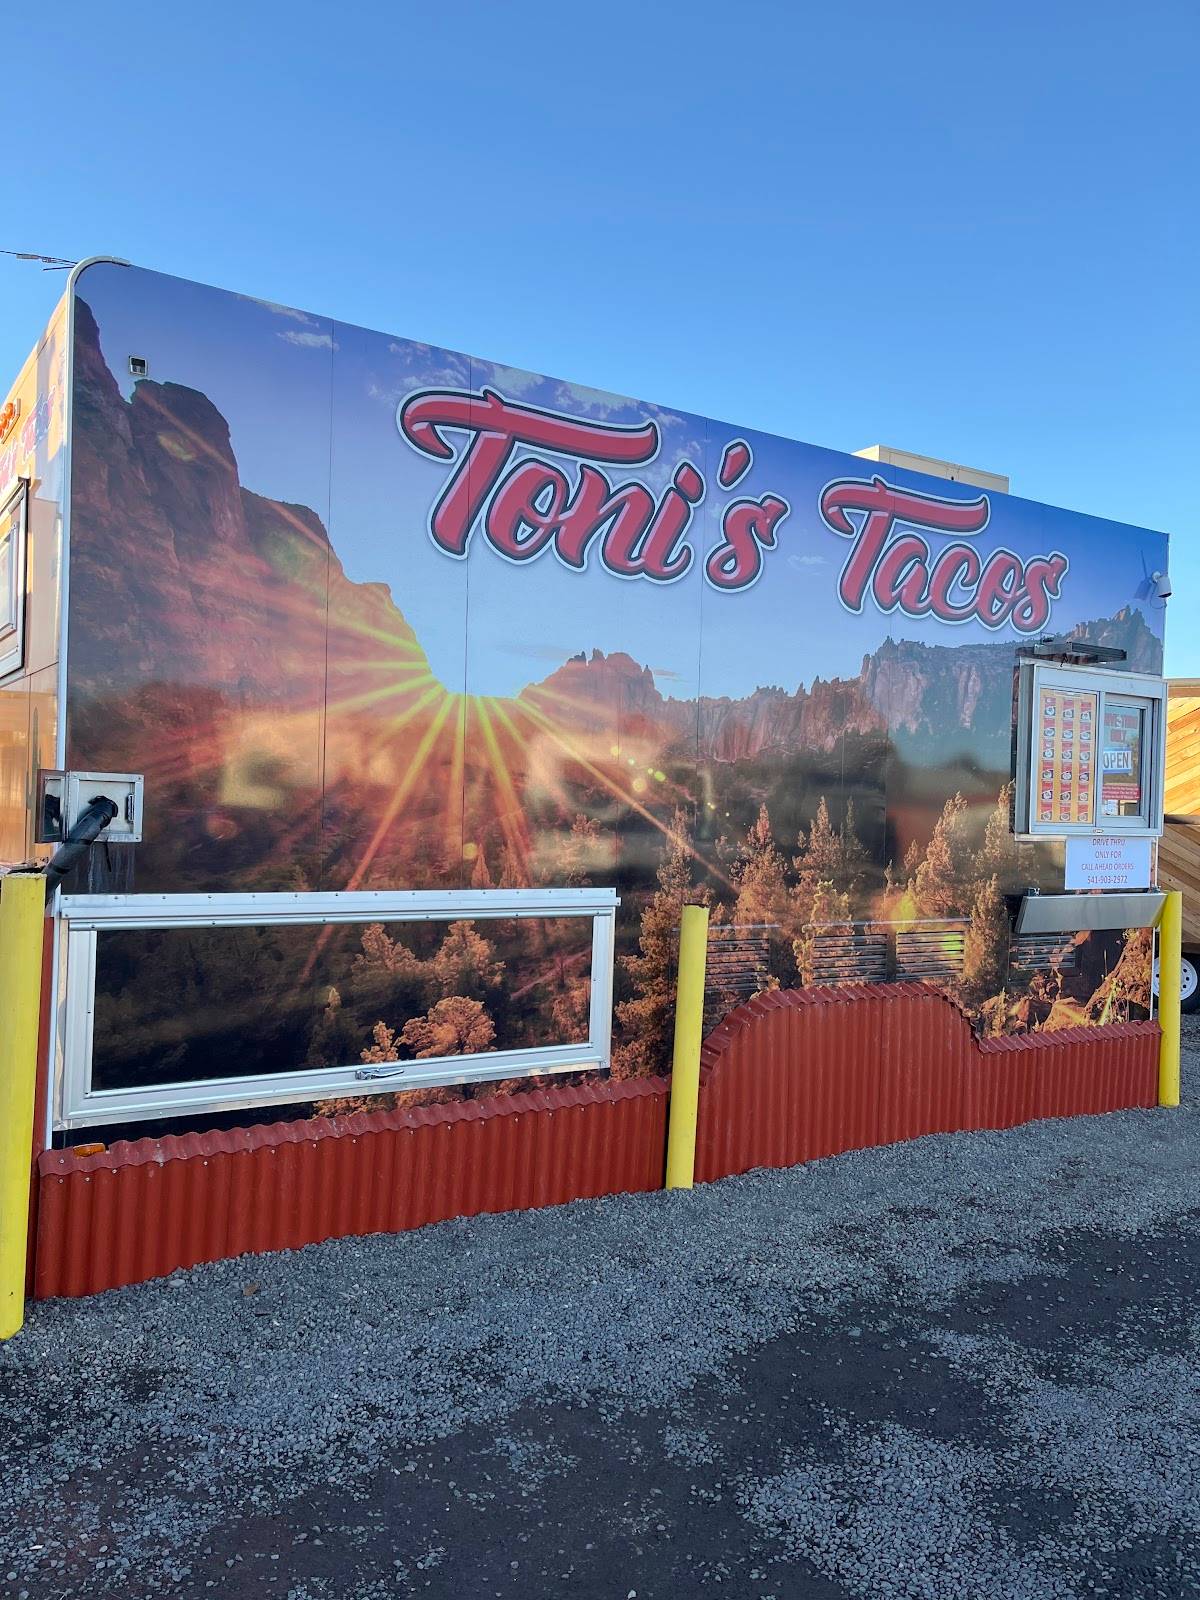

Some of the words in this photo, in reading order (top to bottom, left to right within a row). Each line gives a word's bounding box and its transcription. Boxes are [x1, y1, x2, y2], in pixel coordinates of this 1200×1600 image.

[401, 387, 787, 589] Toni's
[821, 477, 1066, 631] Tacos
[1103, 752, 1129, 769] OPEN
[1092, 838, 1109, 846] DRIVE
[1110, 838, 1126, 846] THRU
[1095, 850, 1110, 859] ONLY
[1110, 850, 1122, 859] FOR
[1081, 863, 1094, 871] CALL
